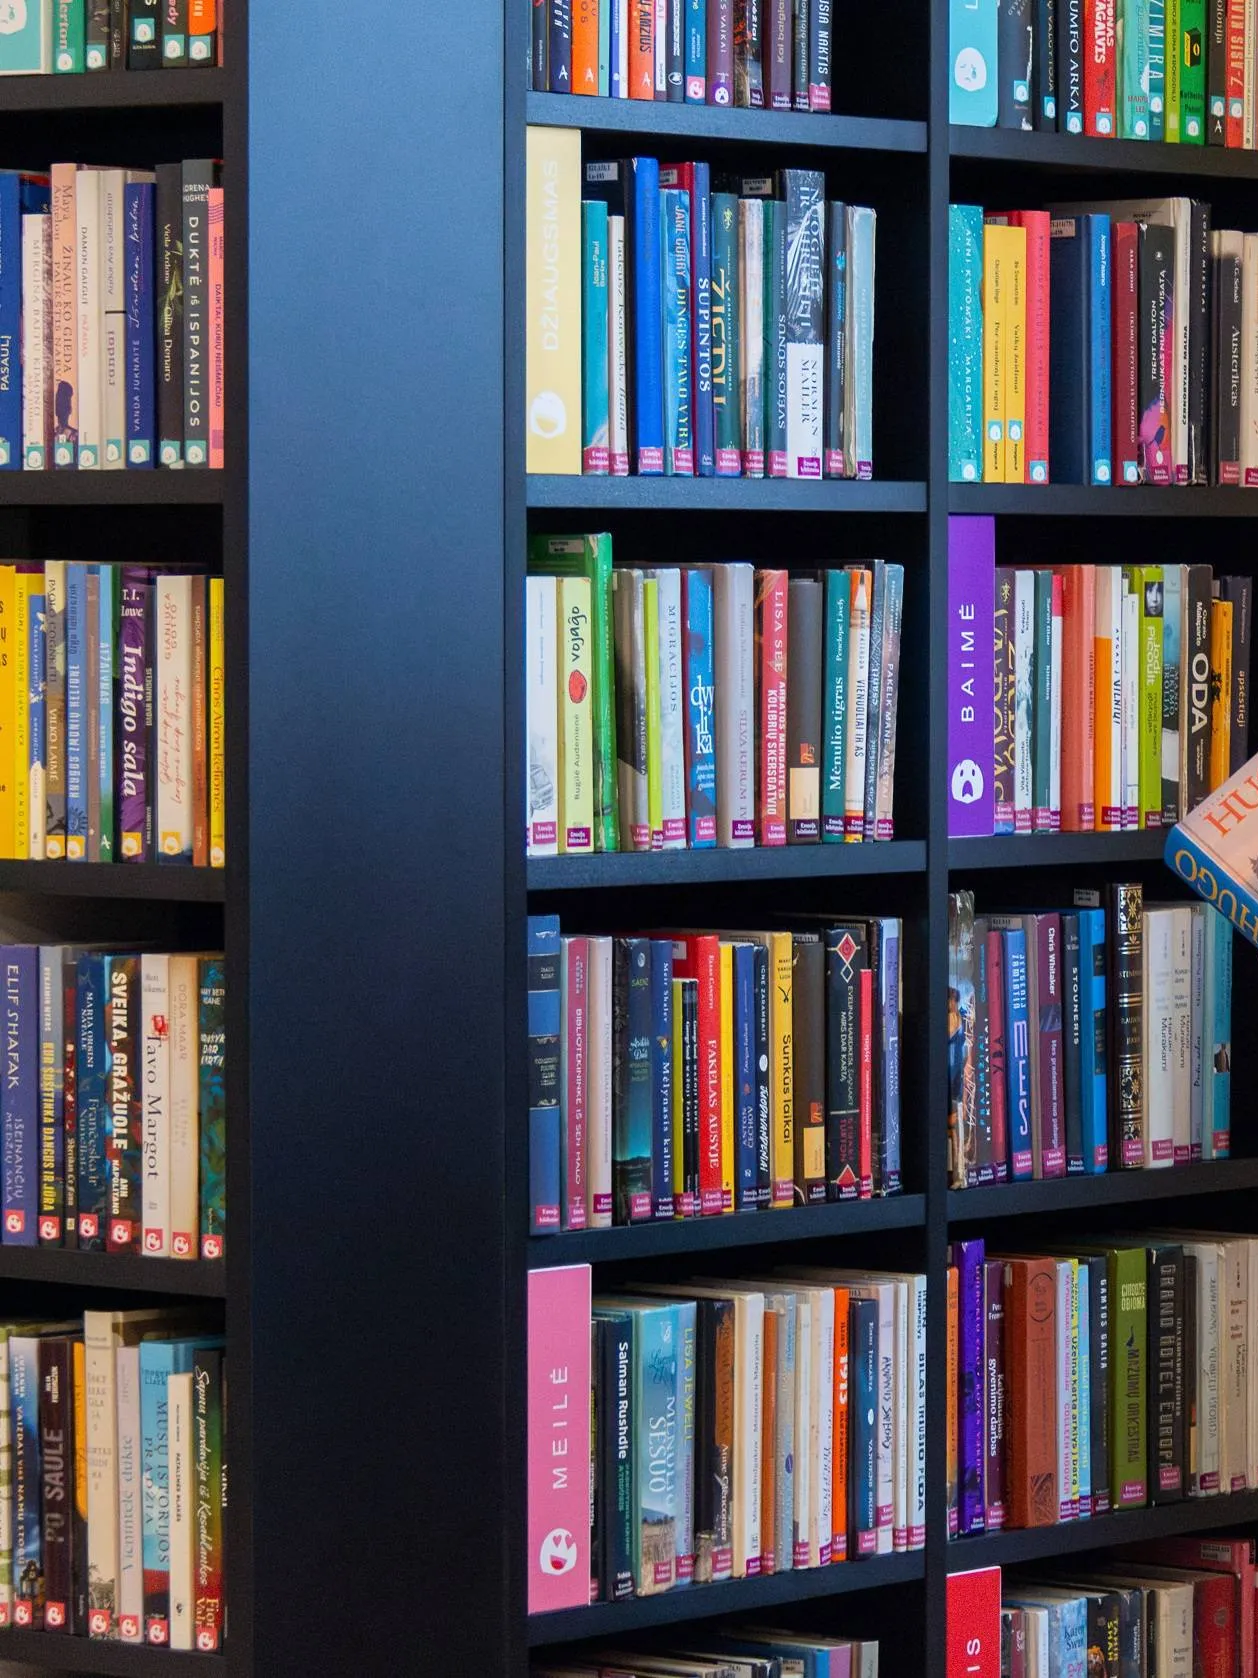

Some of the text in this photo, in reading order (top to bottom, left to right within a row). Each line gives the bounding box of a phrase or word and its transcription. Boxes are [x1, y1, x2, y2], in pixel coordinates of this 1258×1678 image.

[818, 30, 829, 75] NAKTIS
[1070, 59, 1080, 110] ARKA
[61, 185, 73, 220] Maya
[800, 187, 810, 208] IR
[164, 224, 172, 284] Viola Ardone
[540, 162, 560, 350] DŽIAUGSMAS
[674, 206, 687, 277] JANE CORRY
[810, 189, 820, 292] NUOGIEJI
[64, 301, 73, 374] KO GIEDA
[163, 307, 172, 382] Oliva Denaro
[189, 216, 201, 426] DUKTĖ IŠ ISPANIJOS
[676, 289, 688, 397] DINGĘS TAVO
[698, 278, 710, 392] SUPINTOS
[778, 314, 786, 368] SŪNUS
[0, 336, 11, 390] PASAULĮ
[801, 359, 810, 424] MAILER
[810, 360, 818, 436] NORMAN
[1230, 326, 1240, 406] Austerlicas
[48, 580, 57, 618] PAOLO
[774, 592, 784, 674] LISA SEE
[1194, 602, 1203, 646] Malaparte
[667, 605, 678, 712] MIGRACIJOS
[884, 664, 894, 707] PAKELK
[958, 604, 974, 722] BAIMĖ
[1146, 626, 1155, 685] Picoult
[1152, 643, 1160, 674] Jodi
[1191, 653, 1208, 734] ODA
[121, 644, 142, 796] Indigo sala
[830, 677, 844, 790] Mėnulio tigras
[855, 680, 866, 742] VIENUOLIAI IR
[884, 712, 892, 746] MANE
[1236, 670, 1246, 727] apsėstieji
[50, 745, 58, 782] LAIMĖ
[740, 710, 748, 800] SILVA RERUM
[766, 690, 778, 815] KOLIBRIŲ SKERSGATVIO
[1048, 928, 1056, 996] Chris Whitaker
[6, 965, 19, 1088] ELIF SHAFAK
[86, 992, 94, 1068] MARIA ORSINI
[846, 986, 854, 1020] EVELINA
[1072, 968, 1080, 1044] STOUNERIS
[111, 972, 130, 1150] SVEIKA, GRAŽUOLE
[661, 1062, 671, 1132] Mėlynasis
[782, 1034, 792, 1096] Sunkūs
[42, 1042, 56, 1210] KUR SUSITINKA DANGUS IR JŪRA
[88, 1098, 100, 1186] Frančeska ir
[142, 1035, 162, 1180] Tavo Margot
[708, 1040, 719, 1168] FAKELAS AUSYJE
[760, 1085, 768, 1171] JUODAVANDENIAI
[783, 1099, 792, 1144] laikai
[13, 1119, 24, 1198] IŠEINANČIŲ
[112, 1160, 120, 1214] NAPOLITANO
[120, 1178, 128, 1198] ANN
[1159, 1265, 1176, 1394] GRAND HOTEL
[618, 1342, 629, 1458] Salman Rushdie
[684, 1328, 693, 1444] LISA JEWELL
[840, 1353, 848, 1404] 1913
[988, 1358, 998, 1456] gyvenimo darbas
[550, 1366, 568, 1489] MEILĖ
[648, 1416, 666, 1492] SESUO
[720, 1444, 728, 1473] Anne
[1070, 1411, 1078, 1448] arklys
[1128, 1403, 1140, 1463] ORKESTRAS
[144, 1438, 155, 1524] PRADŽIA
[156, 1464, 170, 1564] ISTORIJOS
[198, 1501, 212, 1586] Kasablankos
